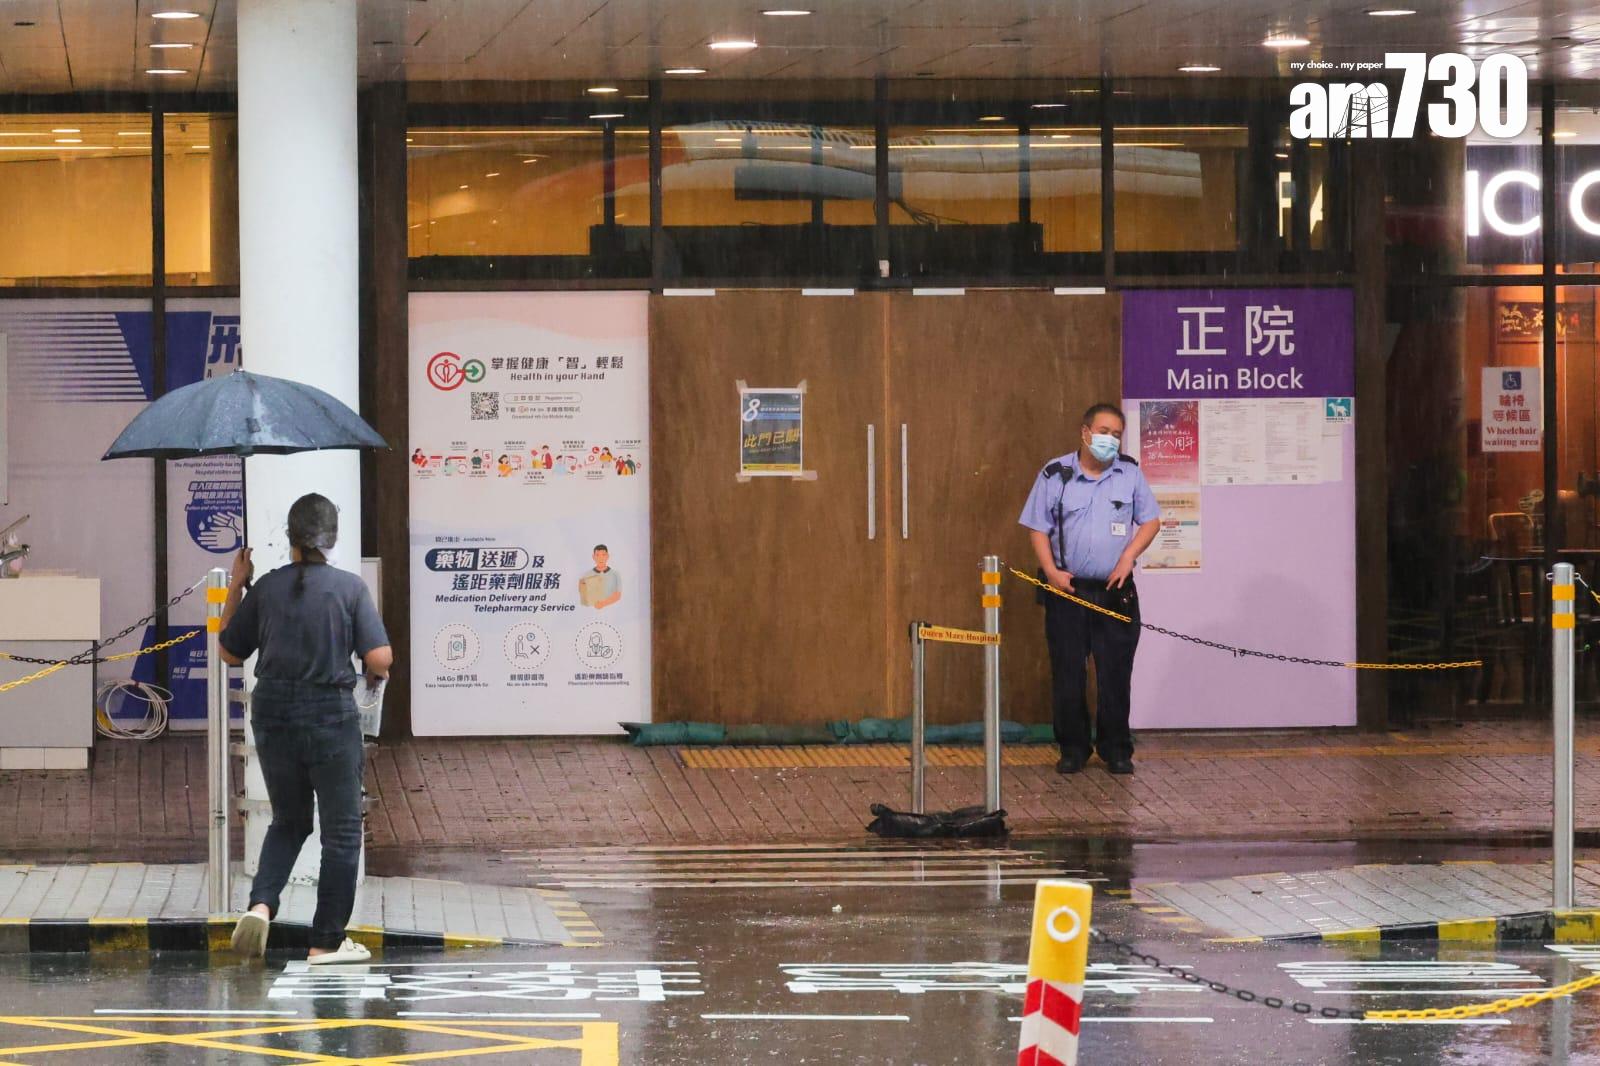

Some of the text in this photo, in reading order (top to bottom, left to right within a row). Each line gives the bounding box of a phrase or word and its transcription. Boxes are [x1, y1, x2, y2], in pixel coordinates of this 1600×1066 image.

[510, 372, 605, 383] Health in your Hand
[1167, 367, 1304, 390] Main Block
[1486, 426, 1537, 435] Wheelchair
[1484, 438, 1517, 447] waiting
[435, 593, 546, 604] Medication Delivery and
[474, 603, 575, 614] Telepharmacy Service
[920, 628, 999, 643] Queen Mary Hospital
